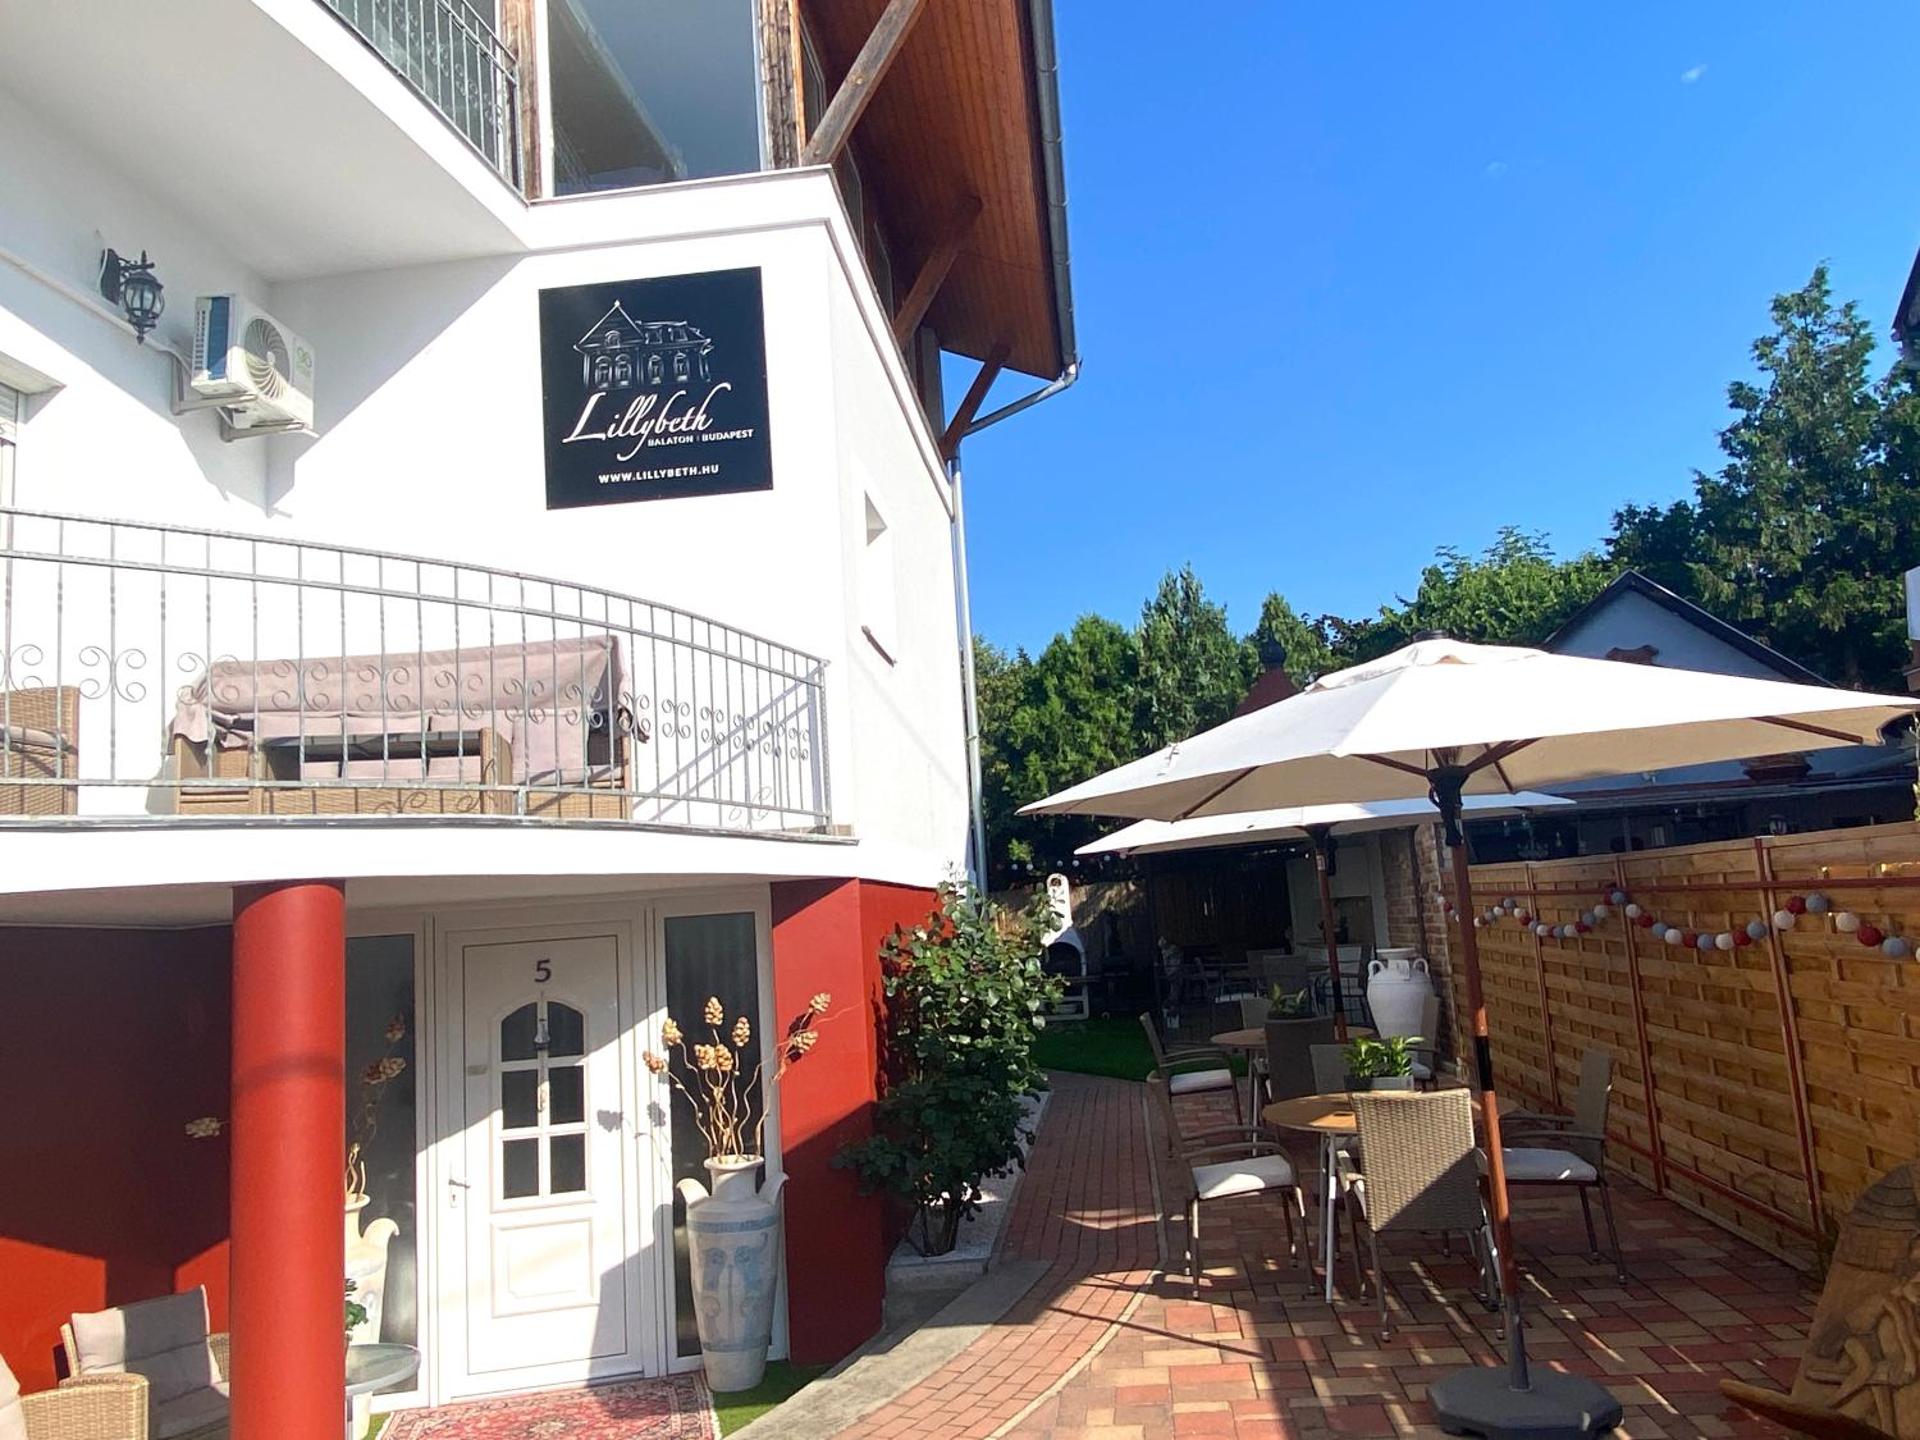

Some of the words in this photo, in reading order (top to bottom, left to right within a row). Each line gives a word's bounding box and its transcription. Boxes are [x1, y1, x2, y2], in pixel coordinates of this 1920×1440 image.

[562, 382, 732, 461] Lillybeth
[647, 435, 694, 447] BALATON
[702, 428, 754, 443] BUDAPEST
[598, 464, 719, 484] WWW.LILLYBETH.HU
[534, 959, 551, 982] 5
